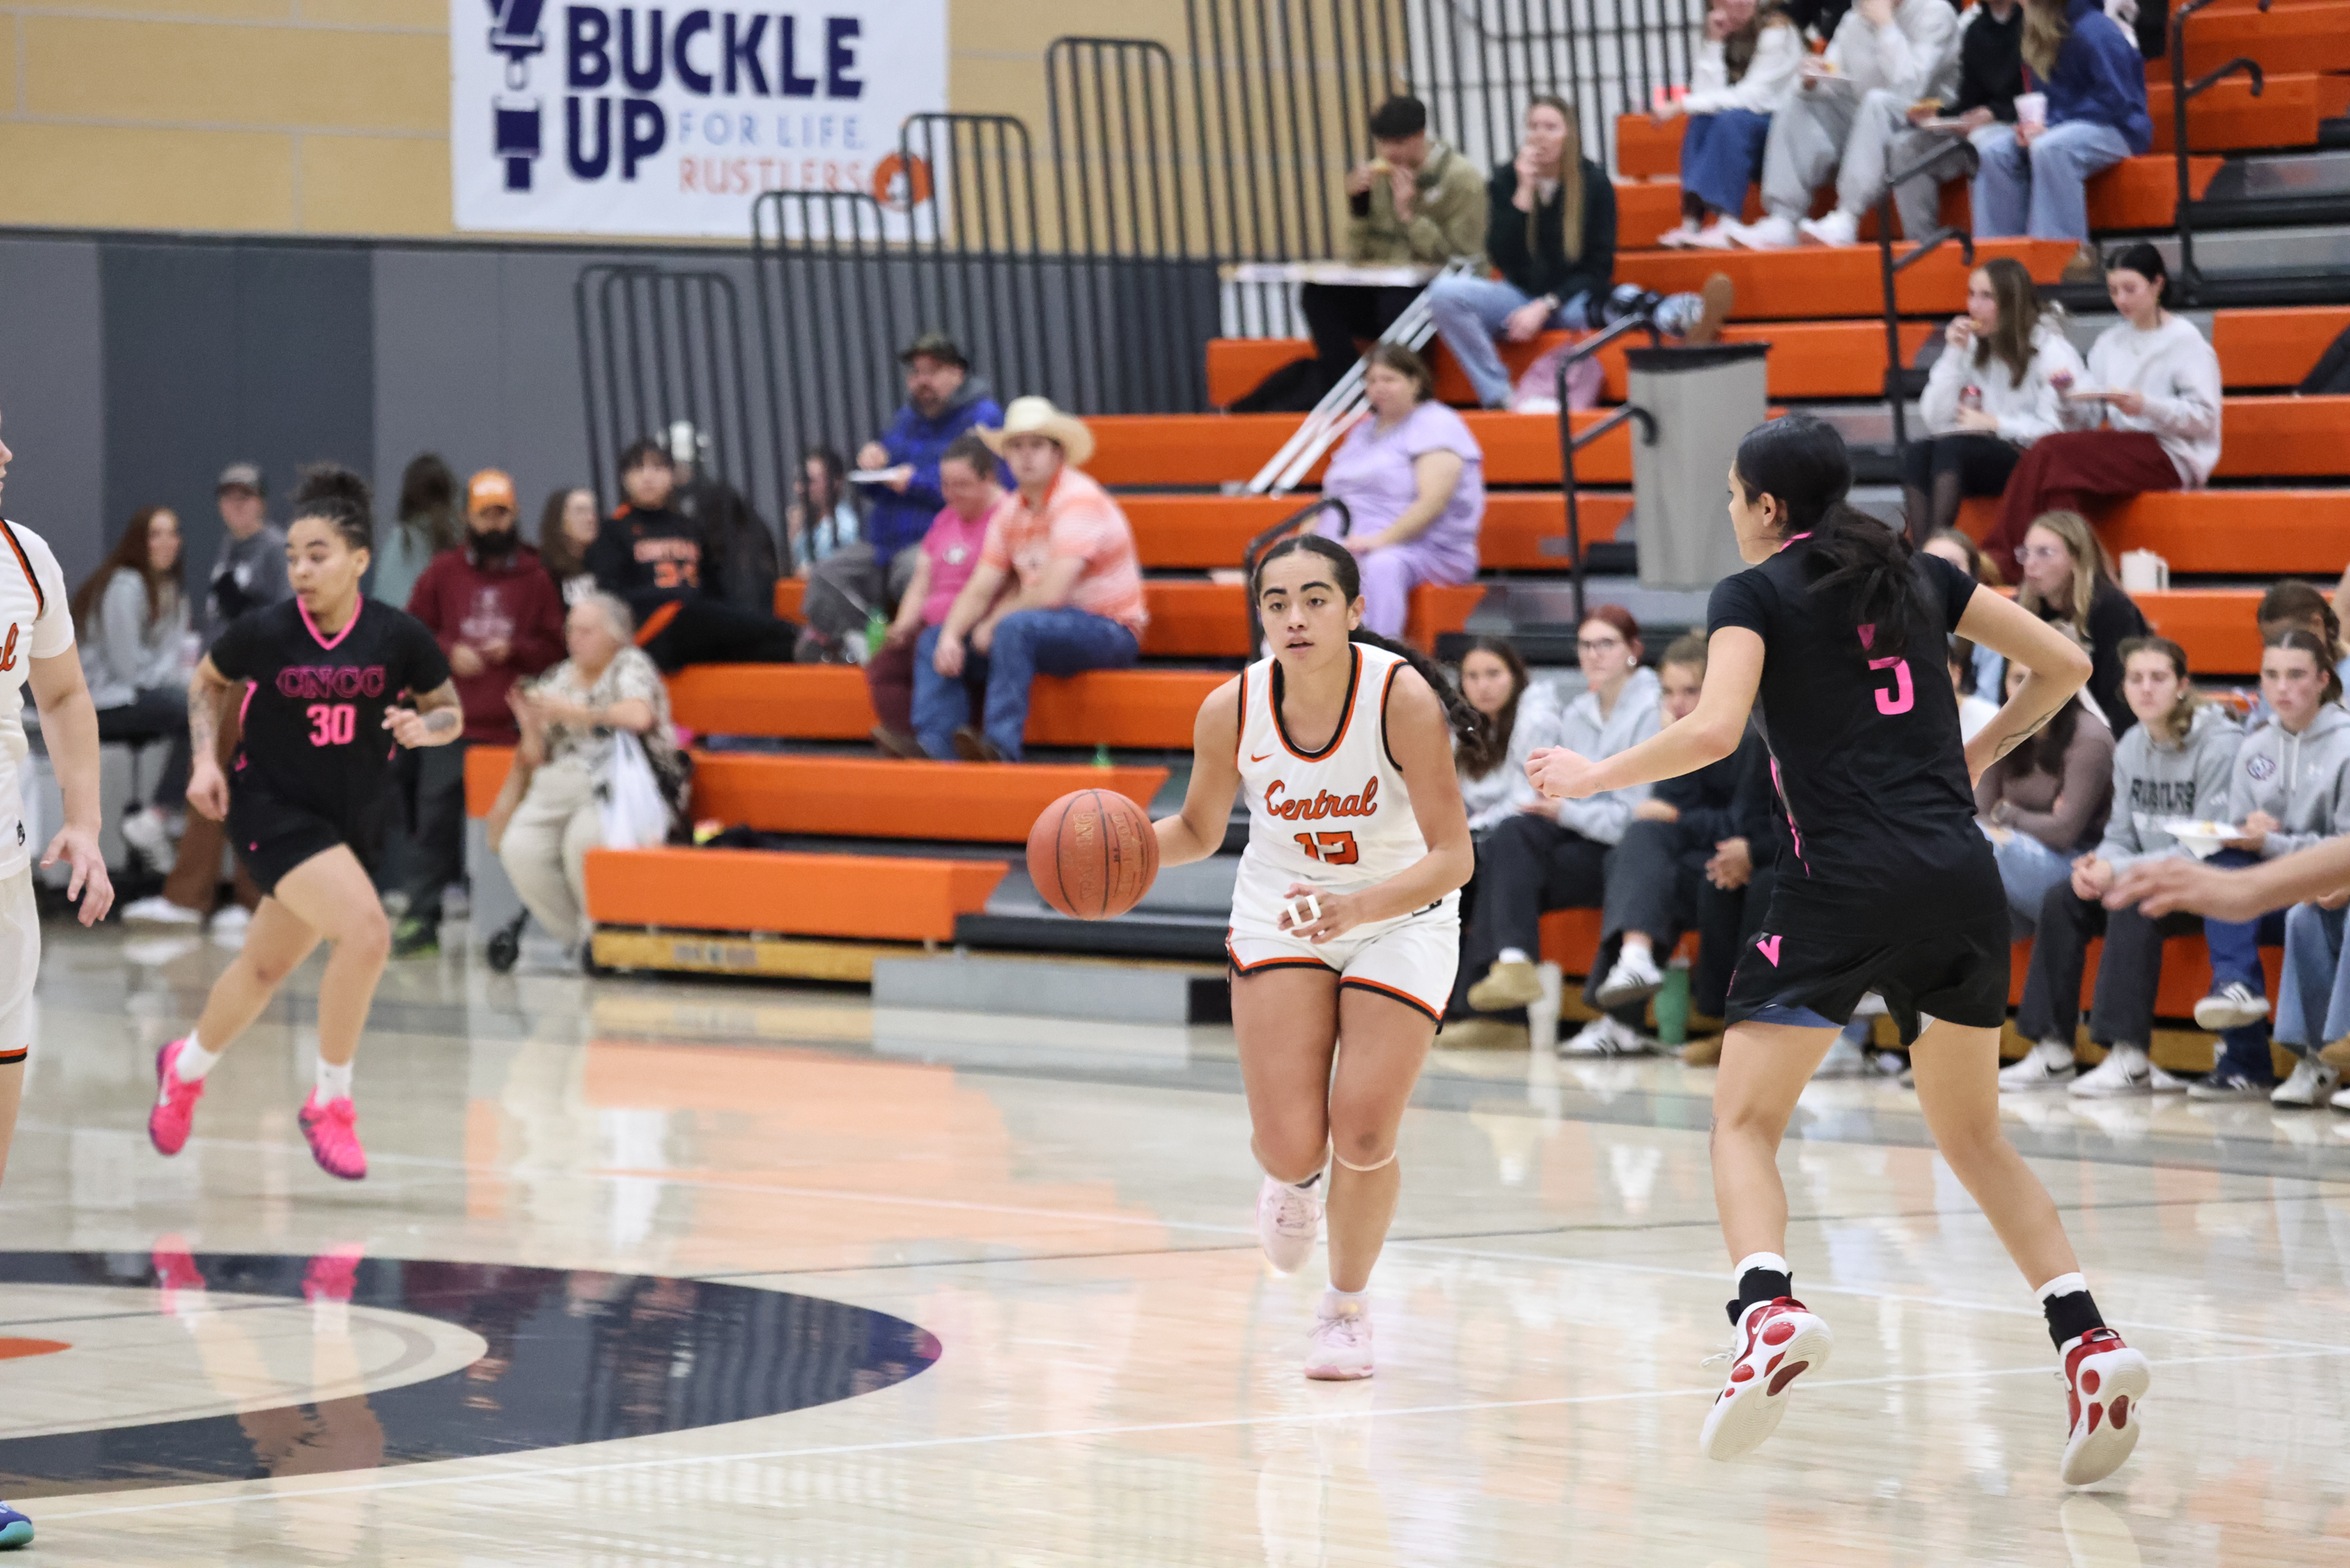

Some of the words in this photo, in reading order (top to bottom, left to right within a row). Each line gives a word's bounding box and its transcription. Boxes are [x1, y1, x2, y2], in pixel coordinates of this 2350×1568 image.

[566, 5, 864, 100] BUCKLE
[566, 97, 666, 182] UP
[677, 109, 757, 147] FOR
[678, 154, 868, 196] RUSTLERS
[276, 664, 386, 698] CNCC
[306, 703, 357, 747] 30
[1264, 775, 1379, 821] Central
